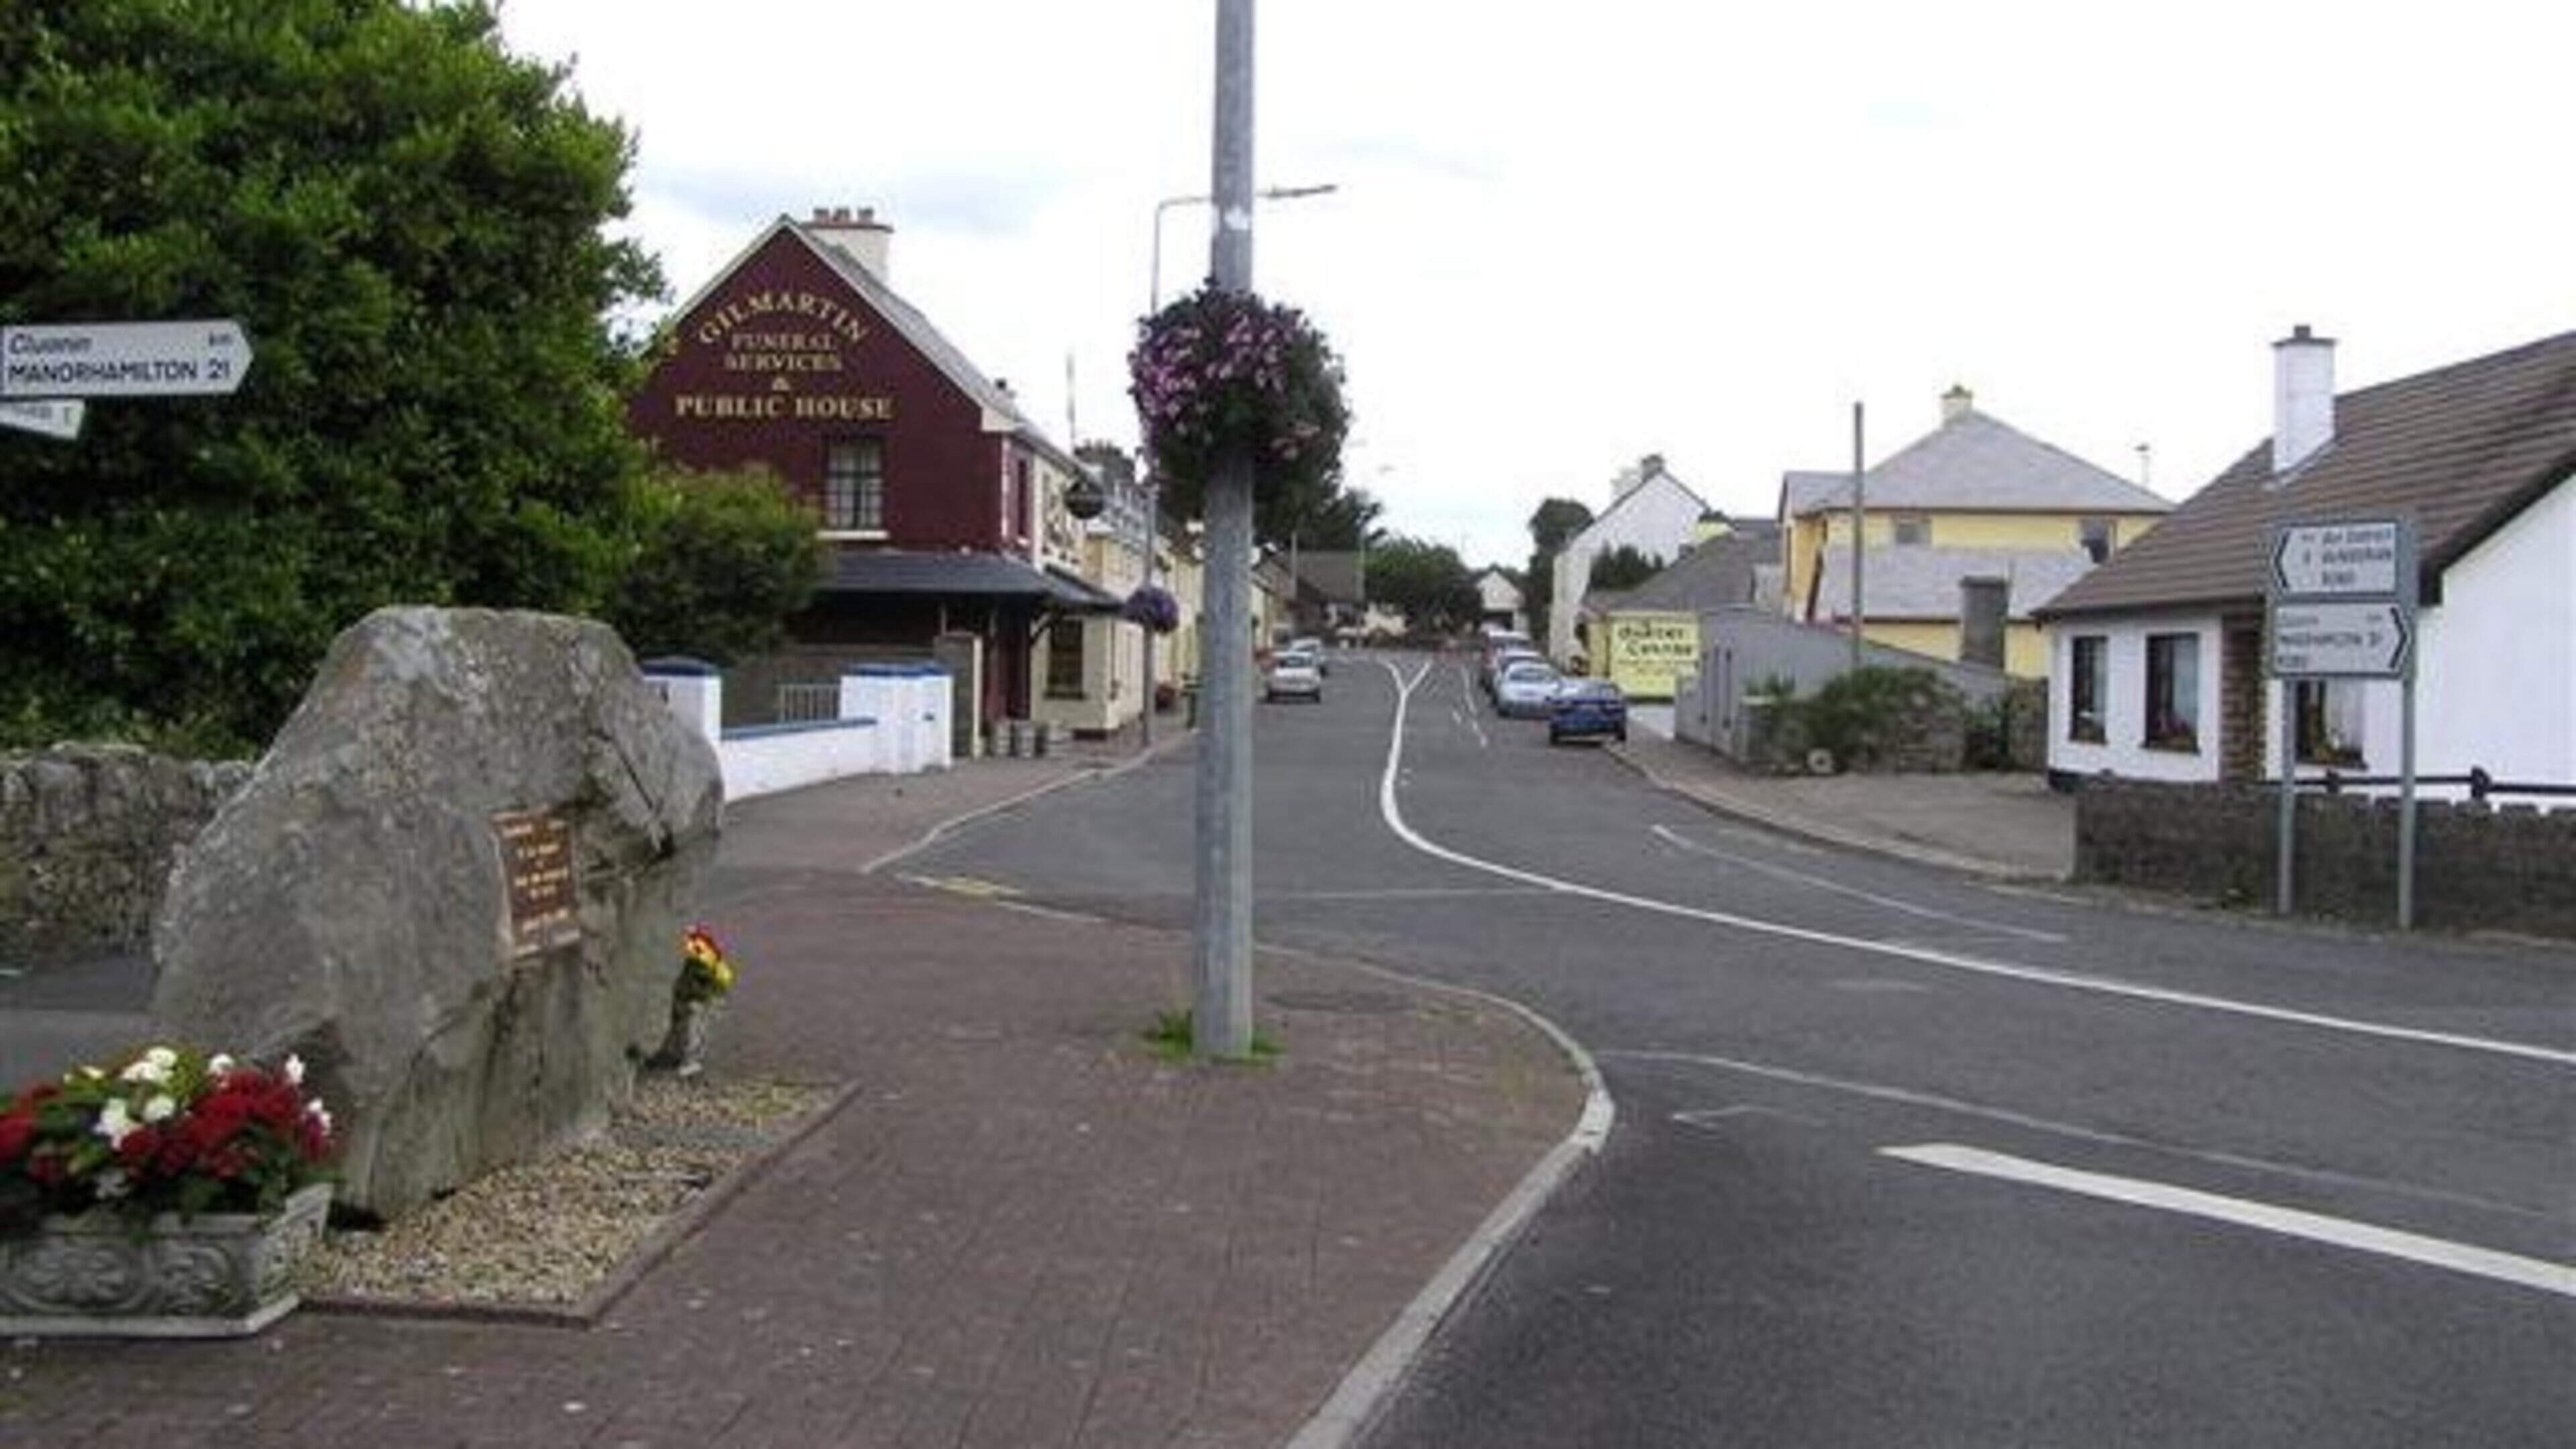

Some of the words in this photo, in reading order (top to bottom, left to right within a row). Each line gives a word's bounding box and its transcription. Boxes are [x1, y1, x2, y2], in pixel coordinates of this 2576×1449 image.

[698, 291, 869, 344] GILMARTIN
[731, 332, 836, 351] FUNERAL
[8, 361, 197, 382] MANORHAMILTON
[207, 358, 231, 380] 21
[723, 352, 843, 372] SERVICES
[674, 396, 786, 419] PUBLIC
[796, 395, 895, 420] HOUSE
